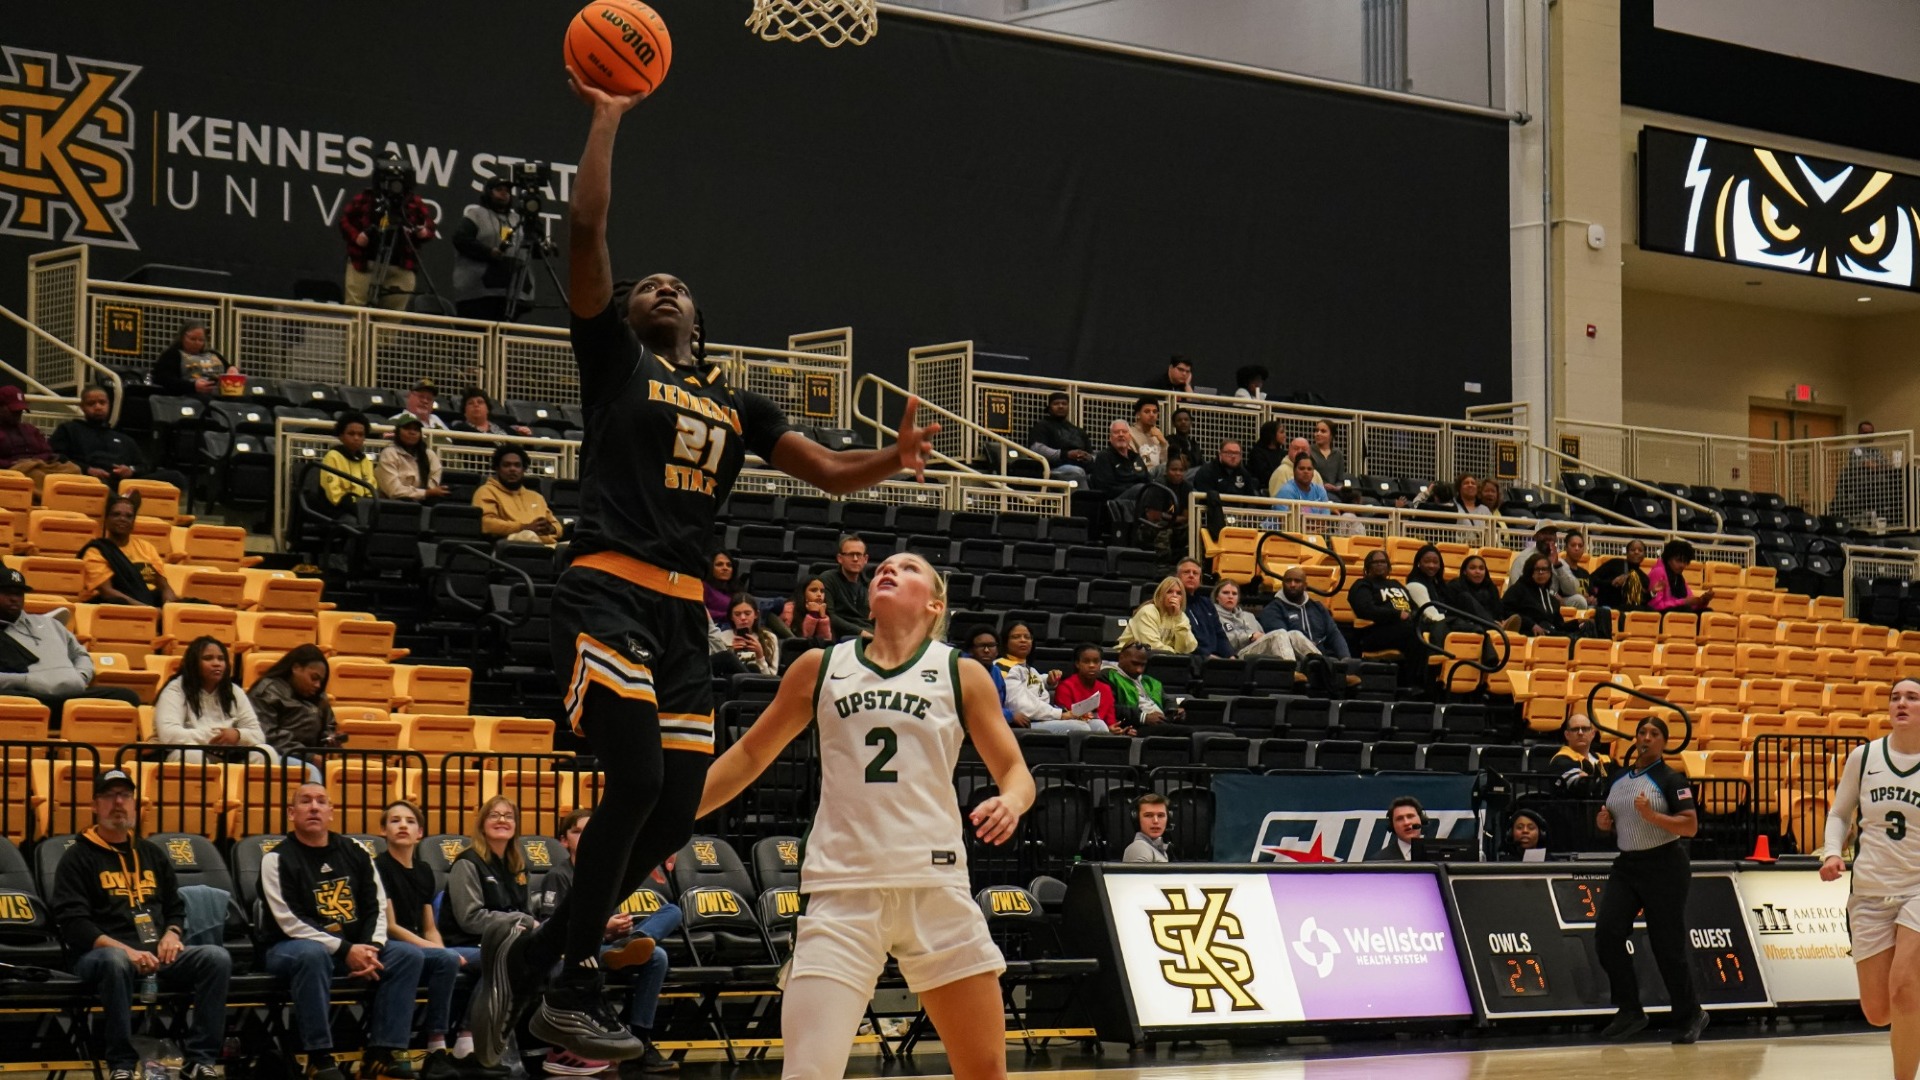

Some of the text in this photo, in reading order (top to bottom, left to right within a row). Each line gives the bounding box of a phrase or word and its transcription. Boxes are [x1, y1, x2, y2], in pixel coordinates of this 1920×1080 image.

[601, 9, 655, 67] Wilson
[113, 319, 134, 332] 114
[812, 385, 828, 397] 114
[991, 402, 1006, 415] 113
[673, 413, 727, 475] 21
[1502, 452, 1515, 463] 113
[835, 690, 931, 720] UPSTATE
[865, 727, 898, 783] 2
[1885, 811, 1906, 841] 3
[99, 869, 157, 889] OWLS
[620, 891, 661, 914] OWLS
[696, 891, 740, 915] OWLS
[991, 891, 1031, 912] OWLS
[1343, 926, 1446, 953] Wellstar
[1488, 932, 1532, 953] OWLS
[1690, 928, 1733, 948] GUEST
[1356, 954, 1428, 966] HEALTH SYSTEM
[1763, 944, 1795, 960] Where
[1796, 944, 1836, 960] students
[1506, 959, 1545, 993] 27
[1716, 953, 1744, 983] 17
